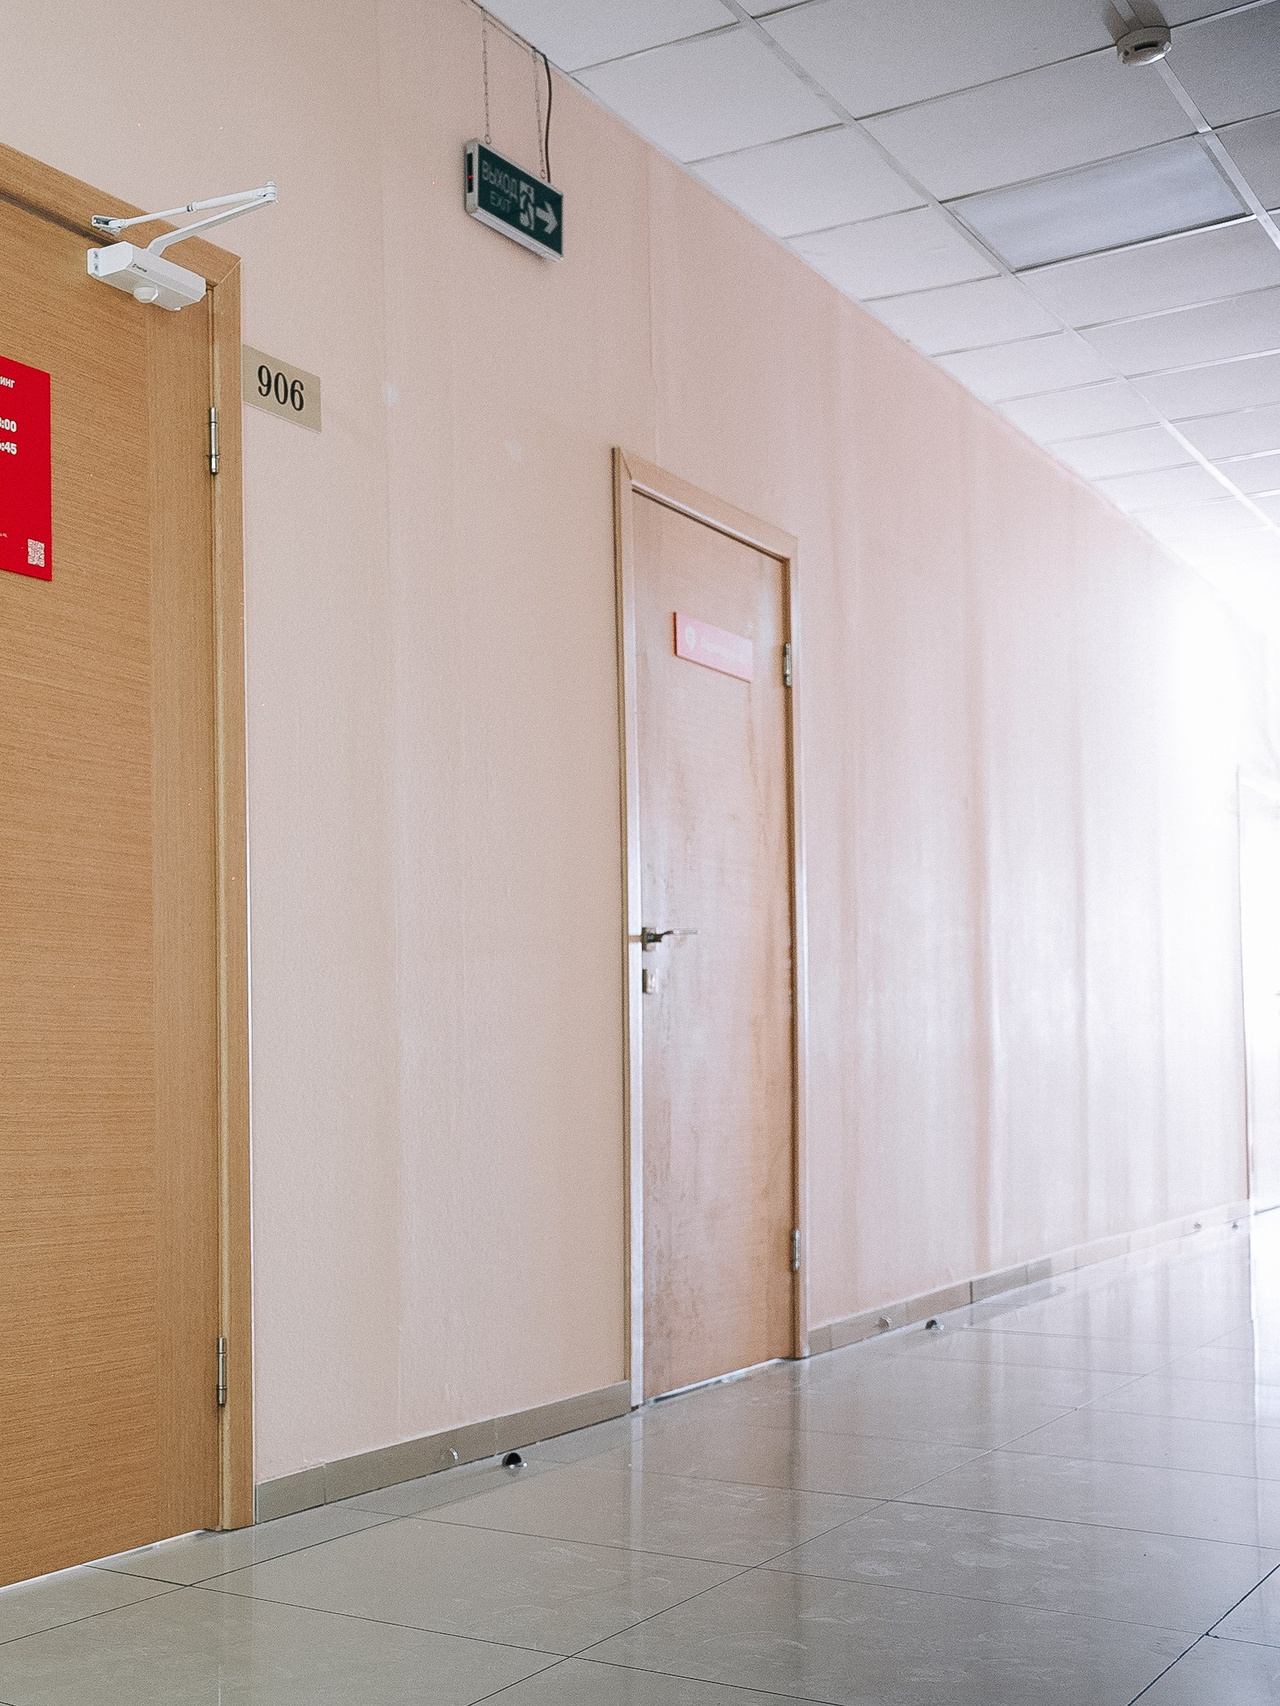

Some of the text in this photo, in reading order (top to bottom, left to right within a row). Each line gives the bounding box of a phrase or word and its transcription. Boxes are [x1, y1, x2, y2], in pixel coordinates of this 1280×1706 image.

[481, 160, 518, 200] ВЫХОД
[489, 190, 511, 213] EXIT
[258, 364, 304, 412] 906
